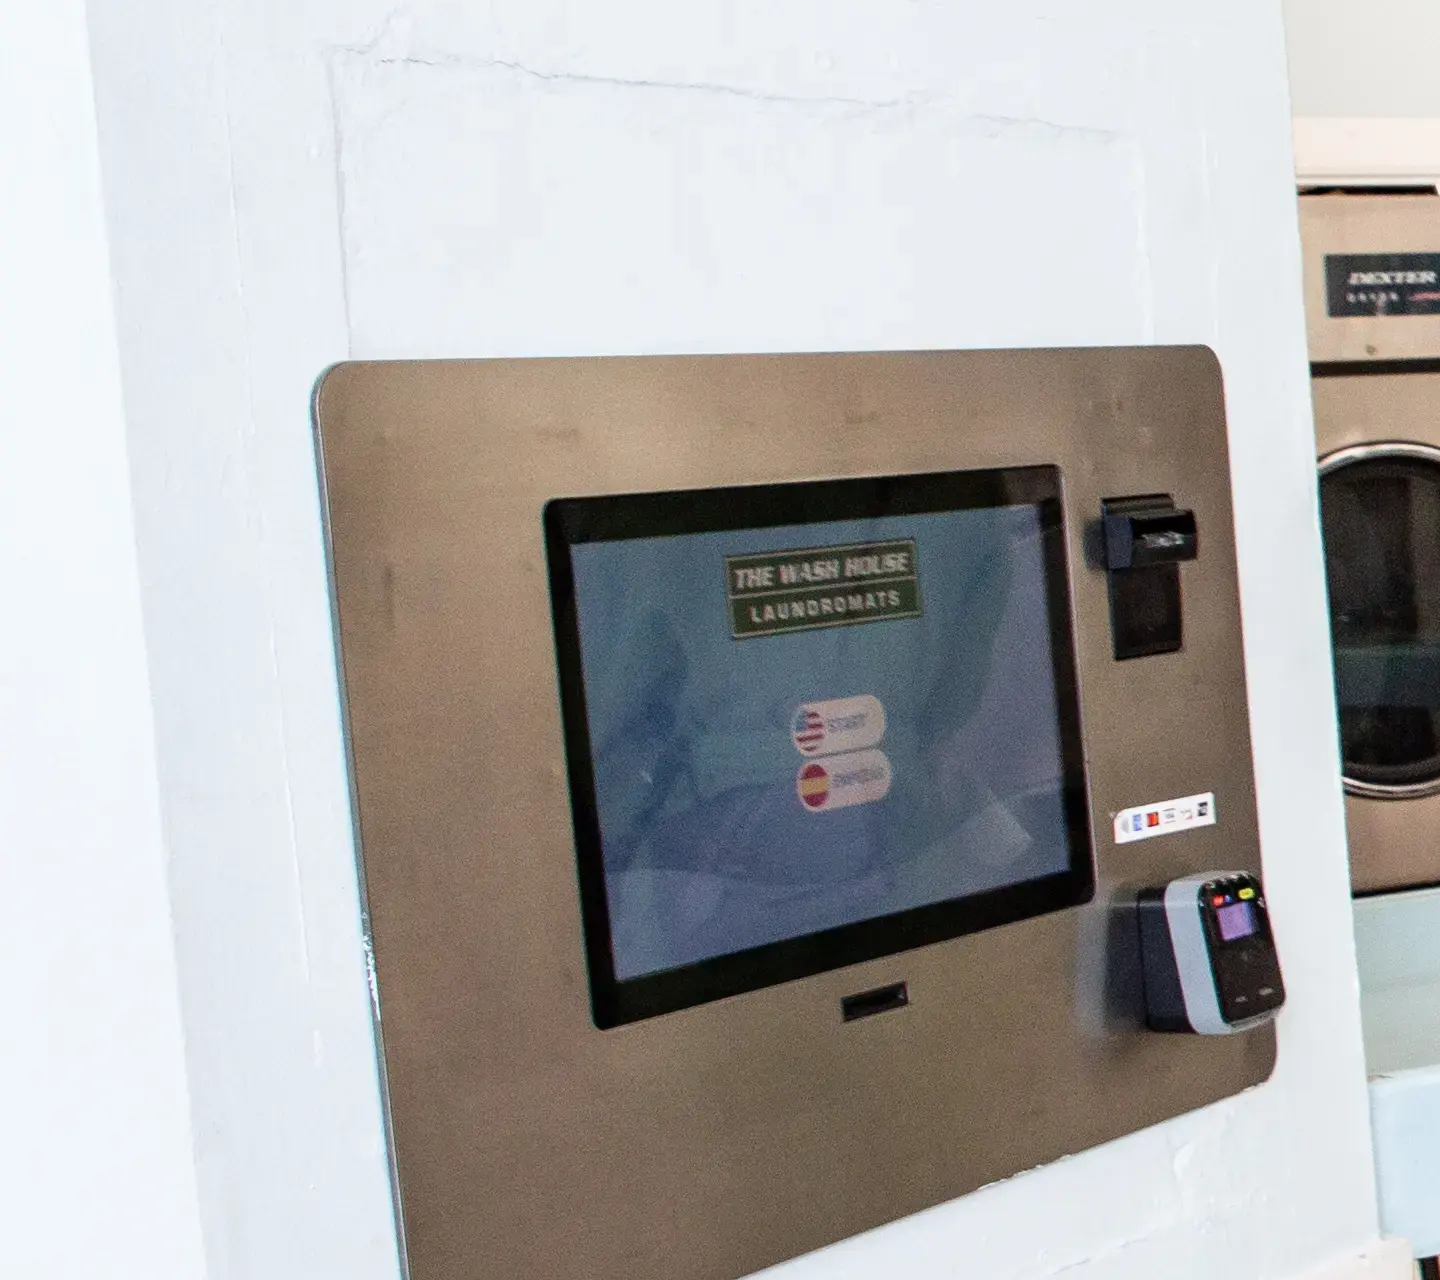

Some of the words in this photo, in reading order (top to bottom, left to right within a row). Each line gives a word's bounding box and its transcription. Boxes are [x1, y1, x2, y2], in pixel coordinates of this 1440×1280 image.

[1347, 271, 1437, 285] DEXTER
[735, 566, 775, 590] THE
[779, 559, 839, 585] WASH
[844, 552, 909, 578] HOUSE
[749, 590, 901, 624] LAUNDROMATS
